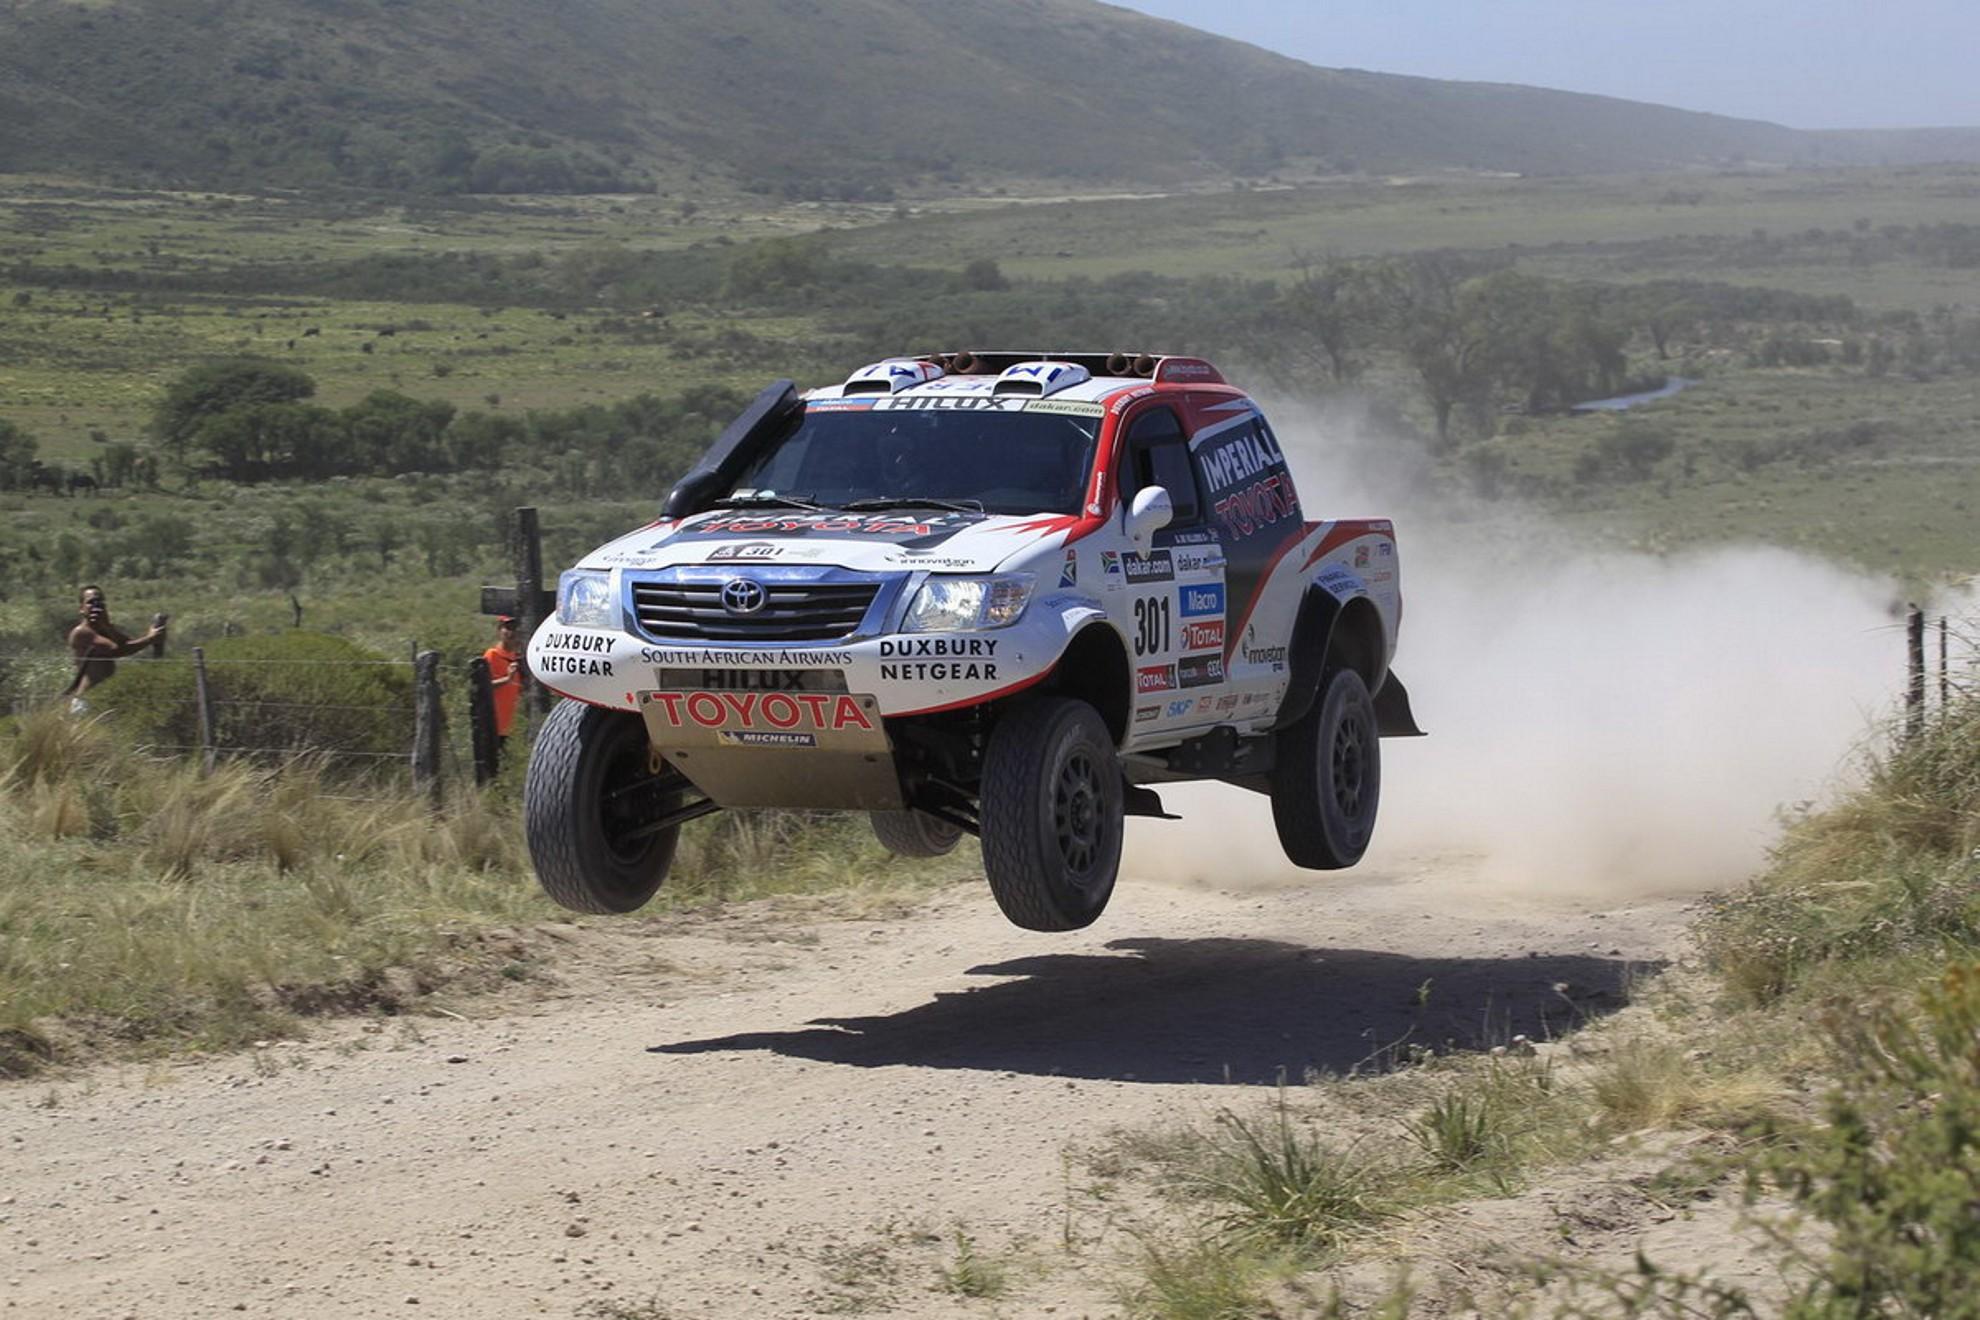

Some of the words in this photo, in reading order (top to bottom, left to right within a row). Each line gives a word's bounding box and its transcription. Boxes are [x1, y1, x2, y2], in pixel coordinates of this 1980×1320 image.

[889, 397, 1006, 411] HILUX
[1028, 401, 1104, 416] dakar.com
[1200, 429, 1283, 493] IMPERIAL
[1215, 472, 1297, 541] TOYOTA
[745, 547, 785, 556] 301
[1188, 590, 1217, 611] Macro
[1134, 595, 1169, 657] 301
[1190, 625, 1223, 646] TOTAL
[545, 633, 616, 654] DUXBURY
[880, 639, 998, 657] DUXBURY
[540, 655, 613, 678] NETGEAR
[641, 647, 696, 664] SOUTH
[702, 649, 774, 665] AFRICAN
[780, 650, 853, 667] AIRWAYS
[702, 668, 804, 691] HILUX
[880, 663, 998, 680] NETGEAR
[1137, 671, 1168, 689] TOTAL
[651, 691, 873, 731] TOYOTA
[1167, 698, 1194, 718] SKF
[742, 733, 813, 745] MICHELIN
